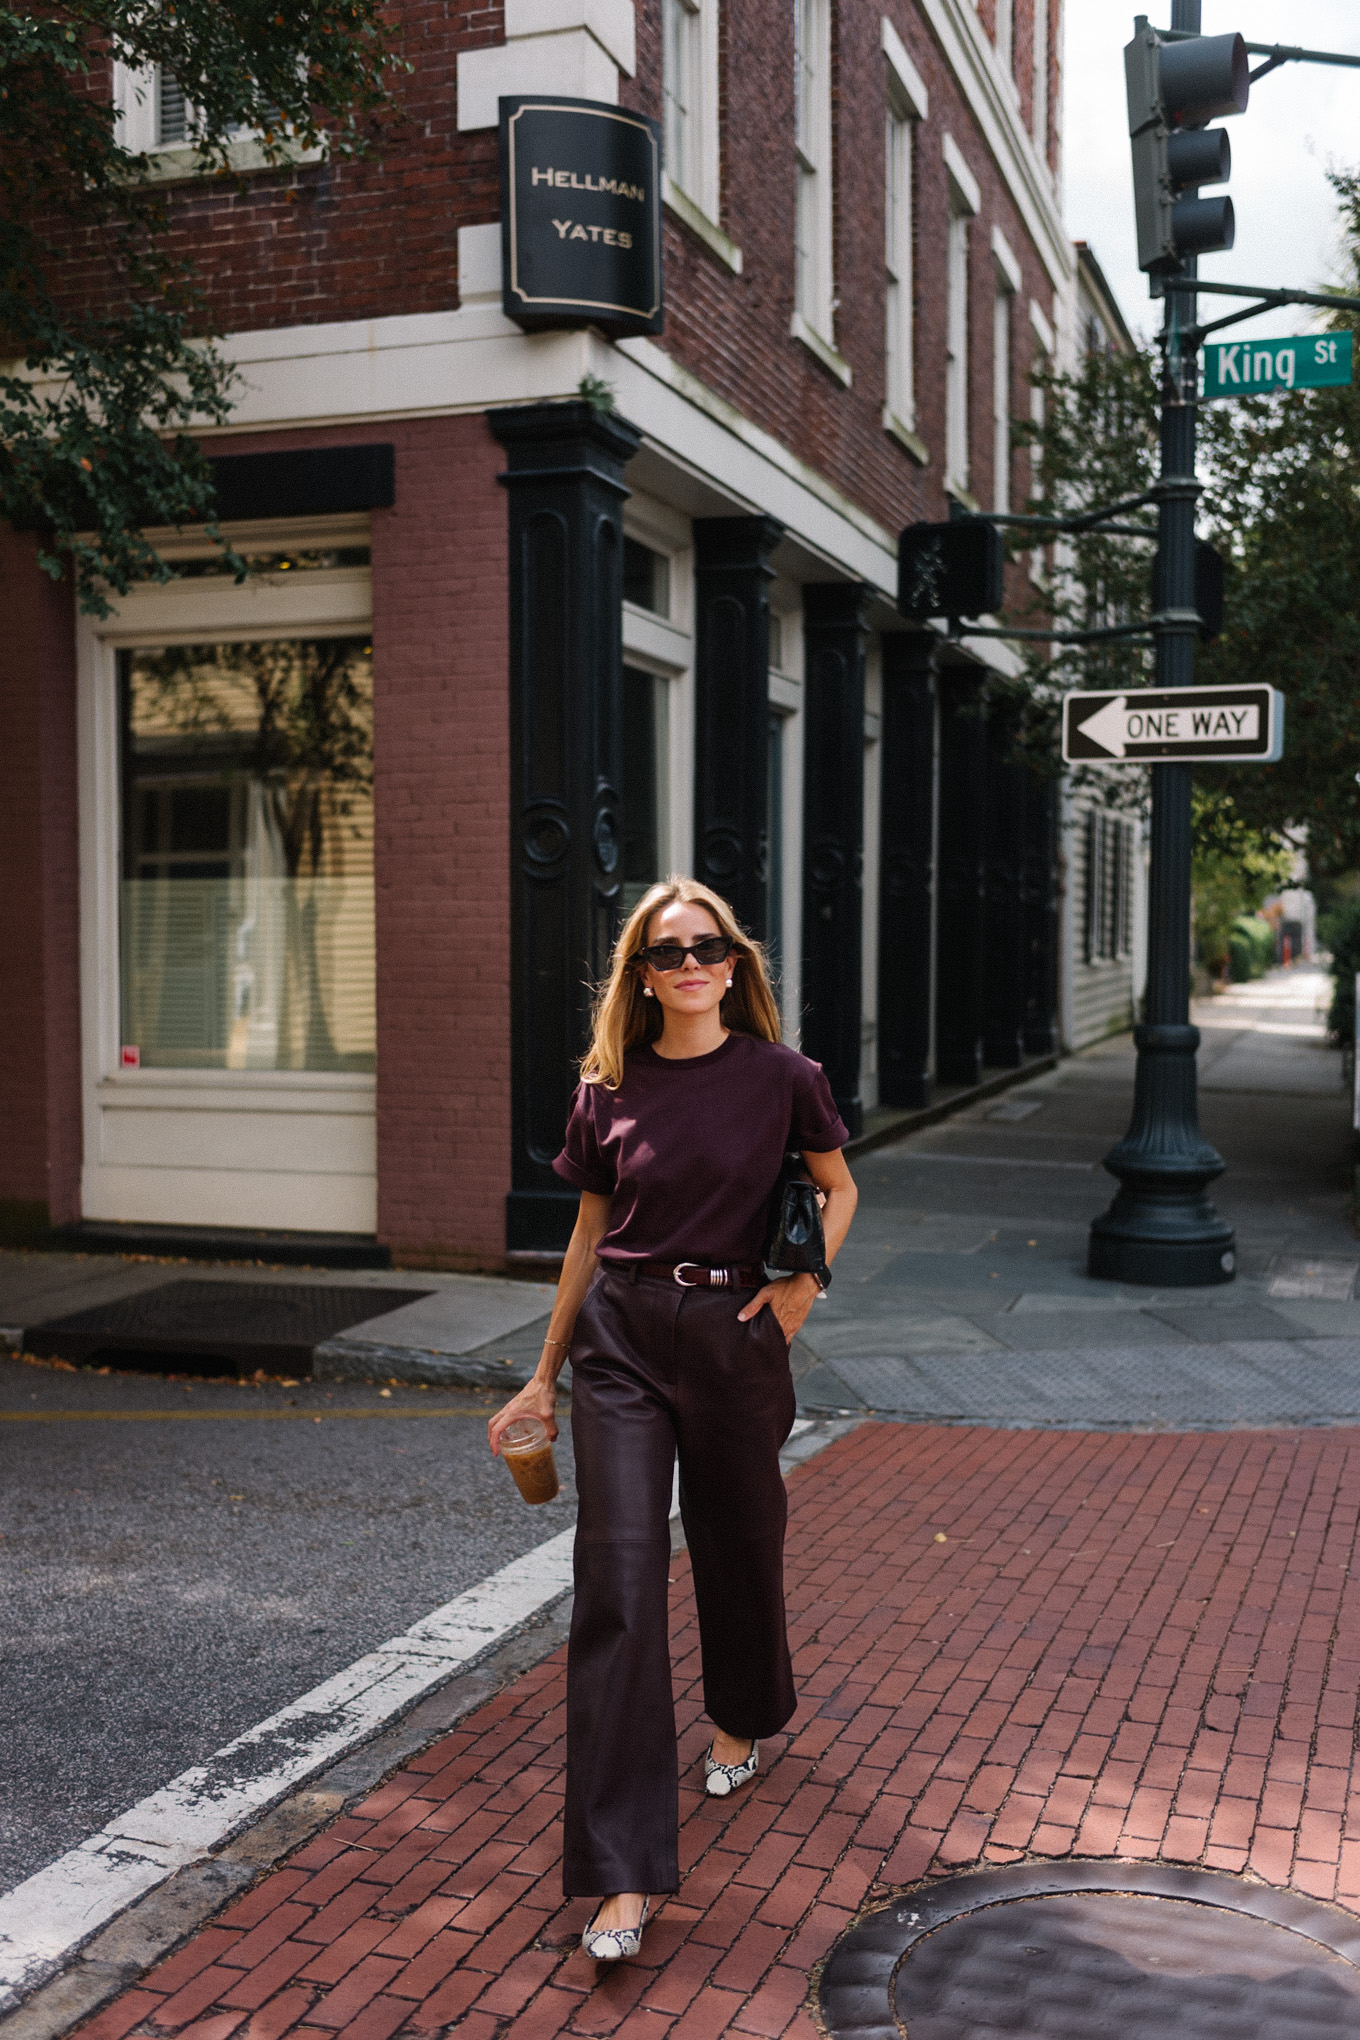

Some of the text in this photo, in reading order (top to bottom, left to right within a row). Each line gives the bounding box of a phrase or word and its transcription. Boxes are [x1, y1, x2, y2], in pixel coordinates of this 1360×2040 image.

[531, 166, 645, 202] HELLMAN
[551, 218, 633, 249] YATES
[1218, 340, 1337, 388] King St
[1127, 710, 1247, 738] ONE WAY
